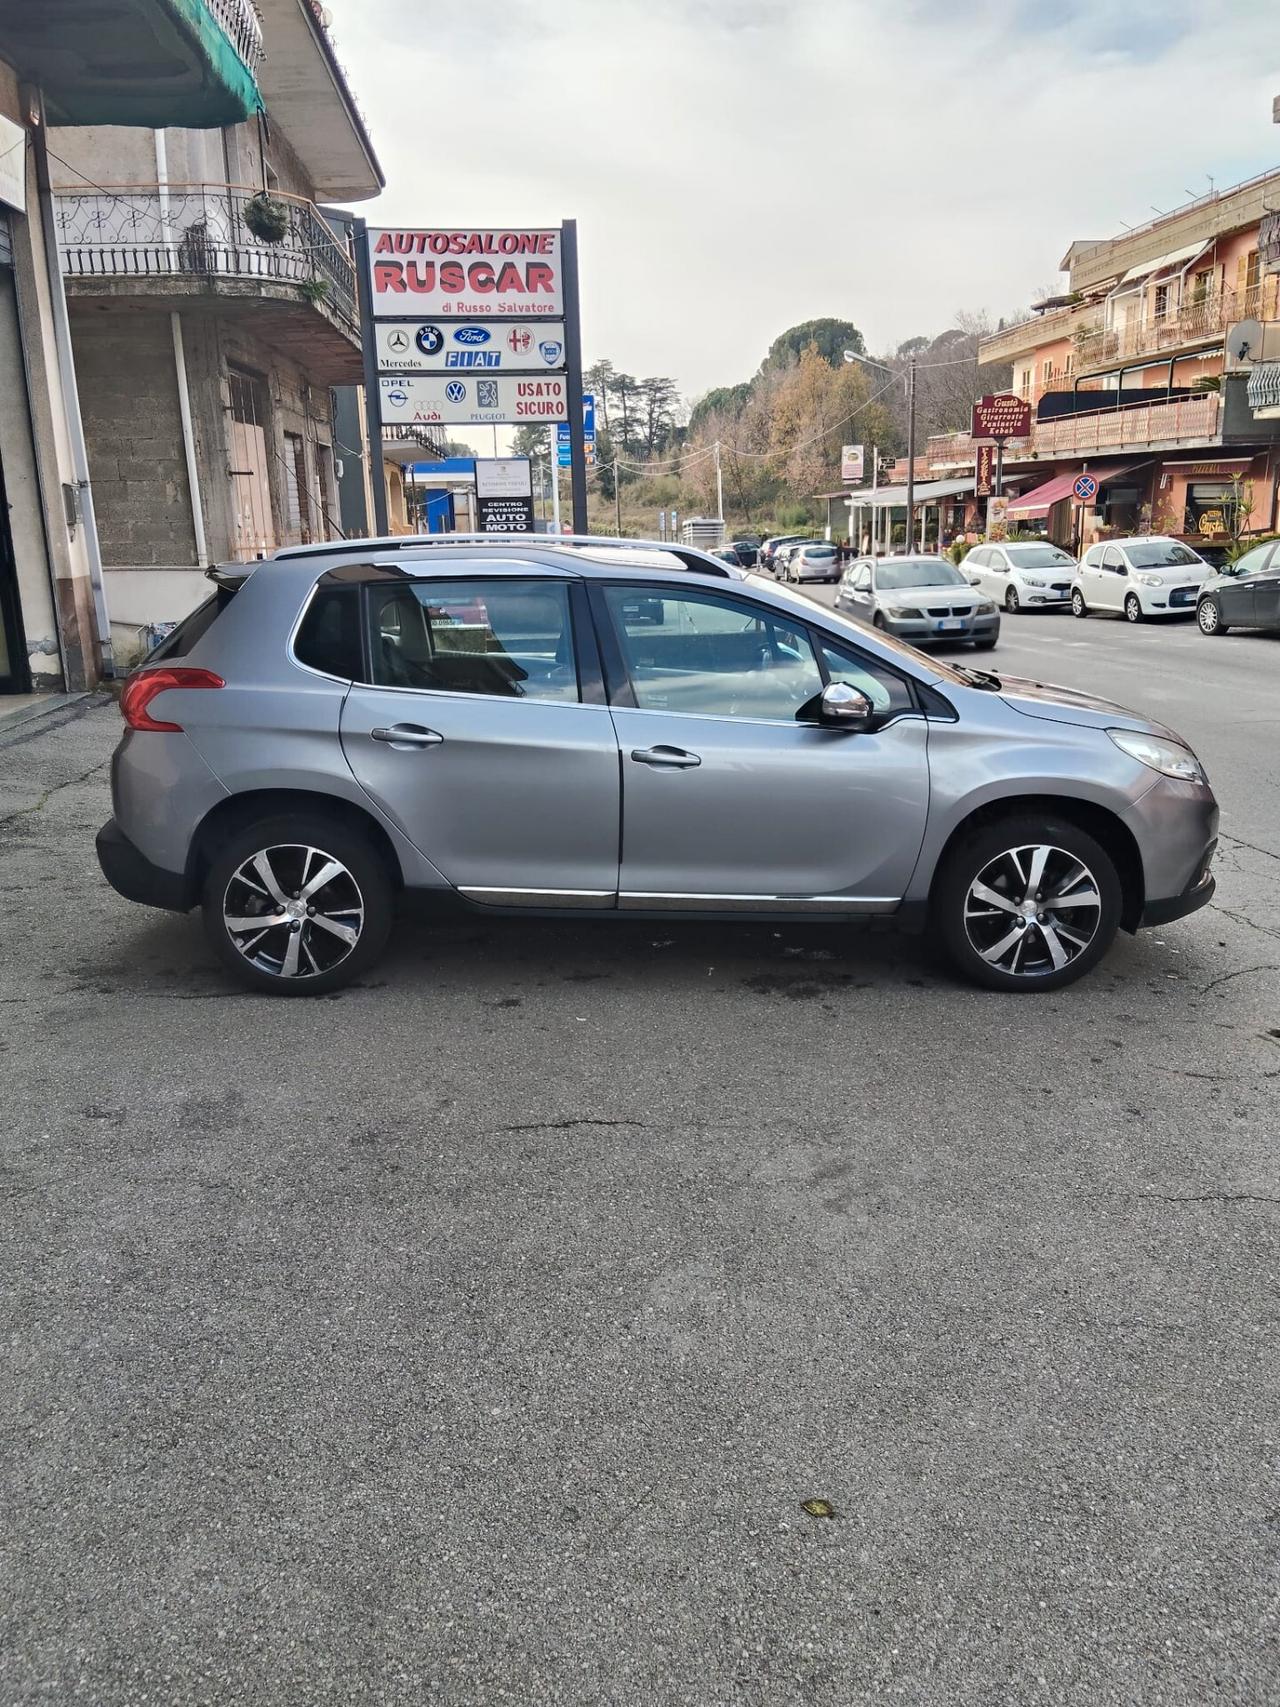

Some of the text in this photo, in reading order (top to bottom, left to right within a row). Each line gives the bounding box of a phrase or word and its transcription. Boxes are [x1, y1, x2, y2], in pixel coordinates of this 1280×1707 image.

[374, 232, 555, 255] AUTOSALONE
[373, 260, 555, 293] RUSCAR
[442, 302, 554, 313] di Russo Salvatore
[459, 329, 486, 342] Ford
[380, 359, 422, 368] Mercedes
[446, 351, 500, 367] FIAT
[381, 379, 414, 387] OPEL
[518, 382, 561, 396] USATO
[516, 402, 564, 415] SICURO
[413, 411, 441, 421] Audi
[470, 413, 506, 421] PEUGEOT
[486, 514, 526, 522] AUTO
[486, 523, 527, 532] MOTO
